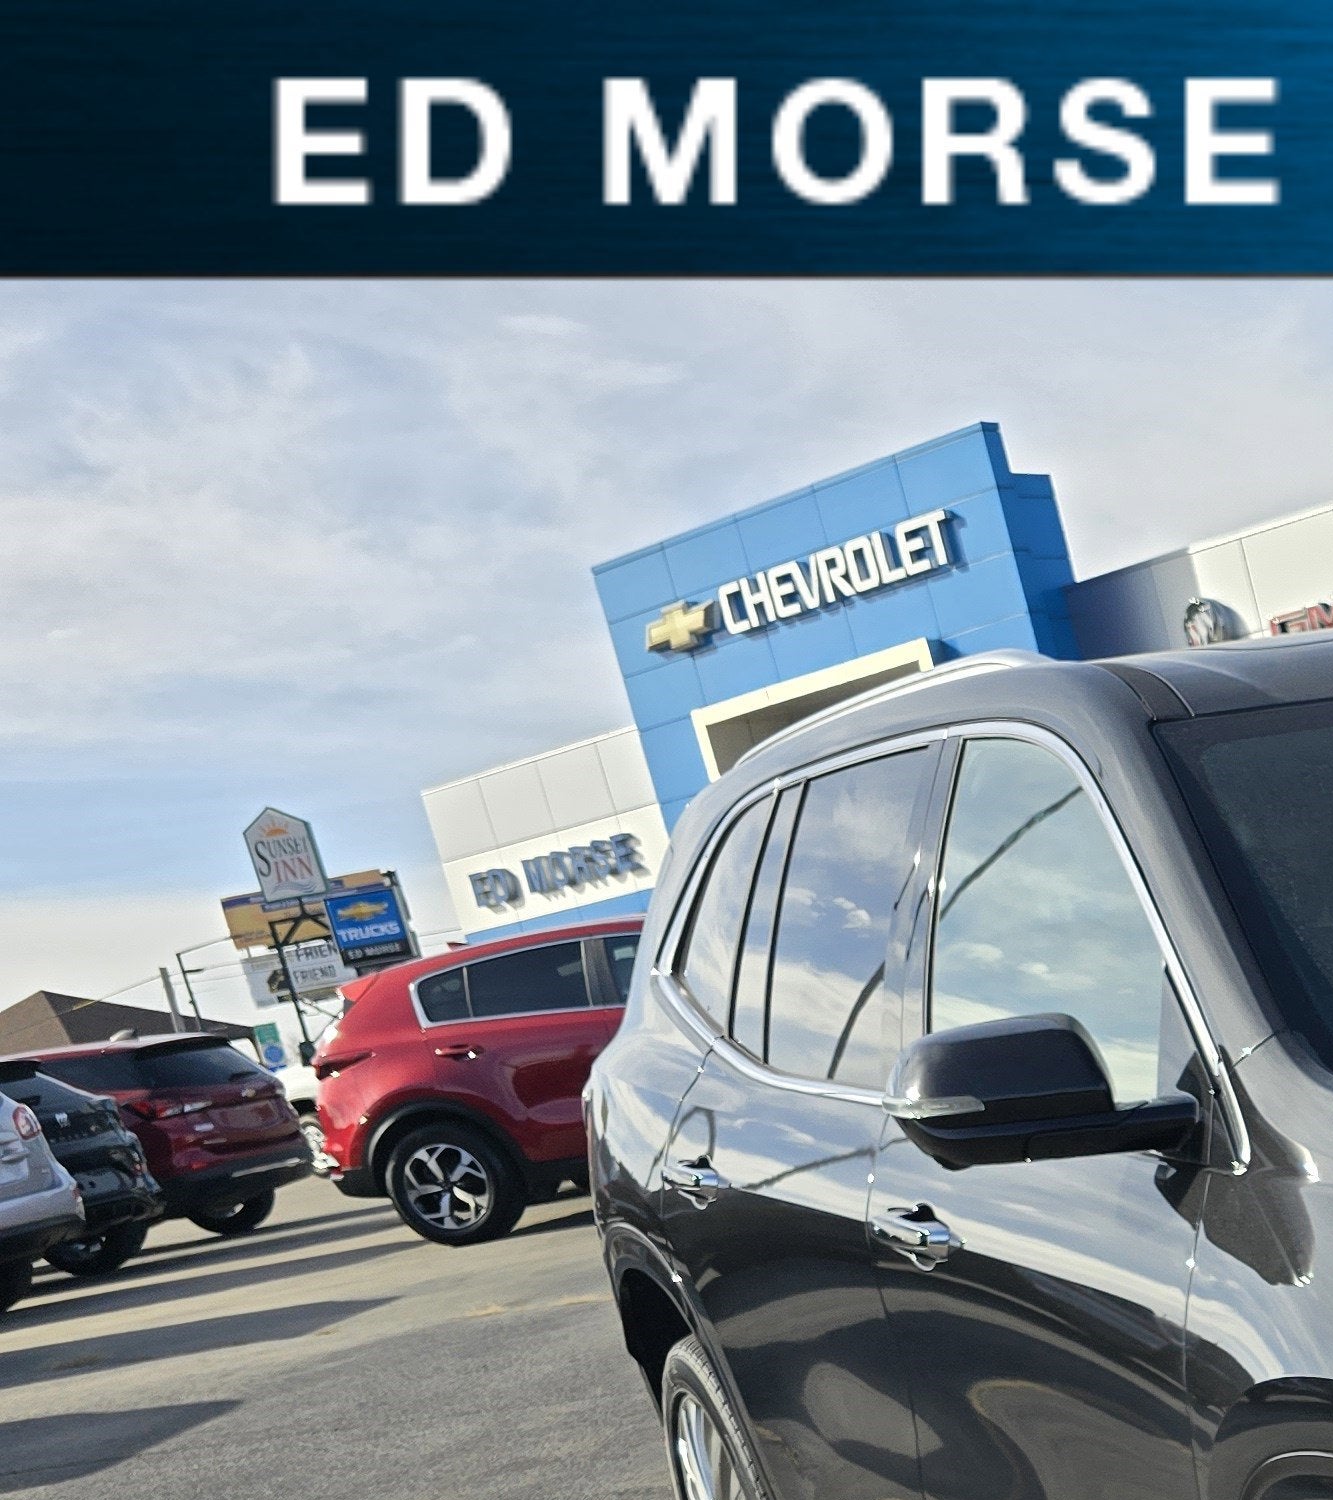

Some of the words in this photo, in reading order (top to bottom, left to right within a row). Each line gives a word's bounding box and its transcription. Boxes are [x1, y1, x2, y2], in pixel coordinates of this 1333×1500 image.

[717, 508, 950, 636] CHEVROLET
[274, 855, 315, 885] INN
[336, 921, 401, 943] TRUCKS
[294, 943, 340, 962] FRIEN
